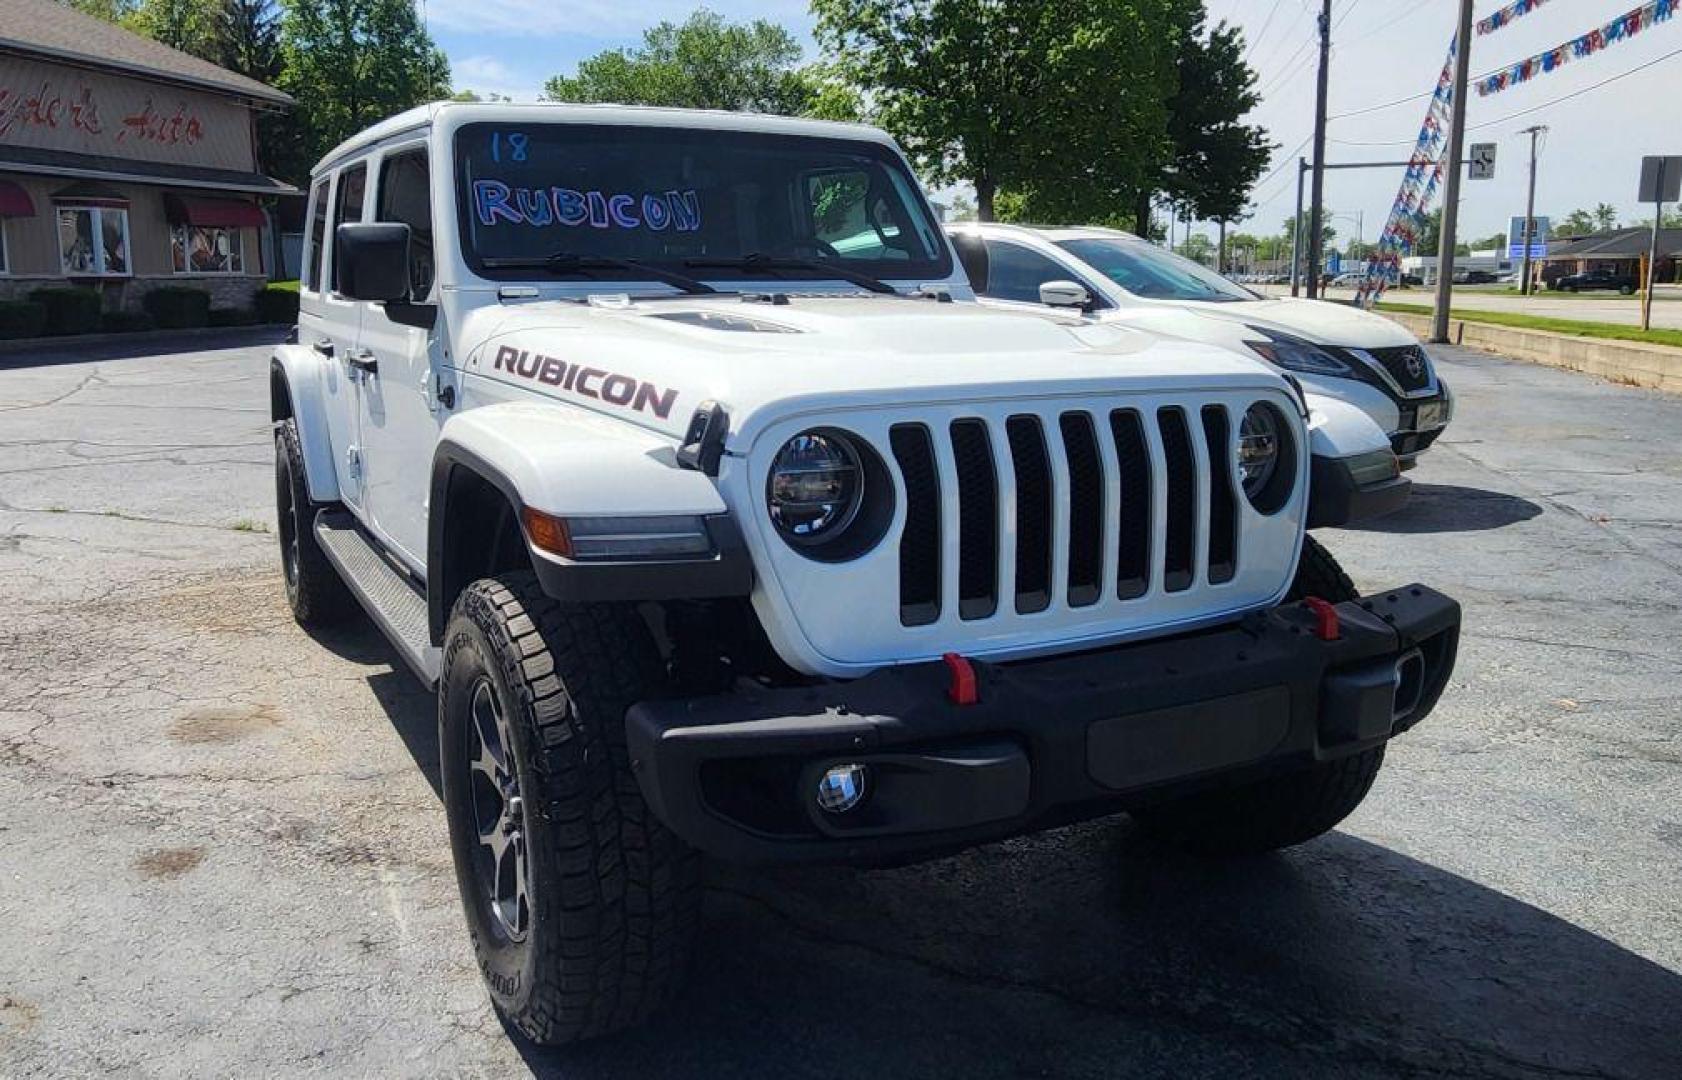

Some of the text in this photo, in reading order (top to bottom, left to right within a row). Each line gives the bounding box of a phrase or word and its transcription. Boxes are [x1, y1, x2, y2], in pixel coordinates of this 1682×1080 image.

[492, 132, 529, 161] 18
[473, 179, 701, 231] RUBICON
[494, 344, 681, 420] RUBICON
